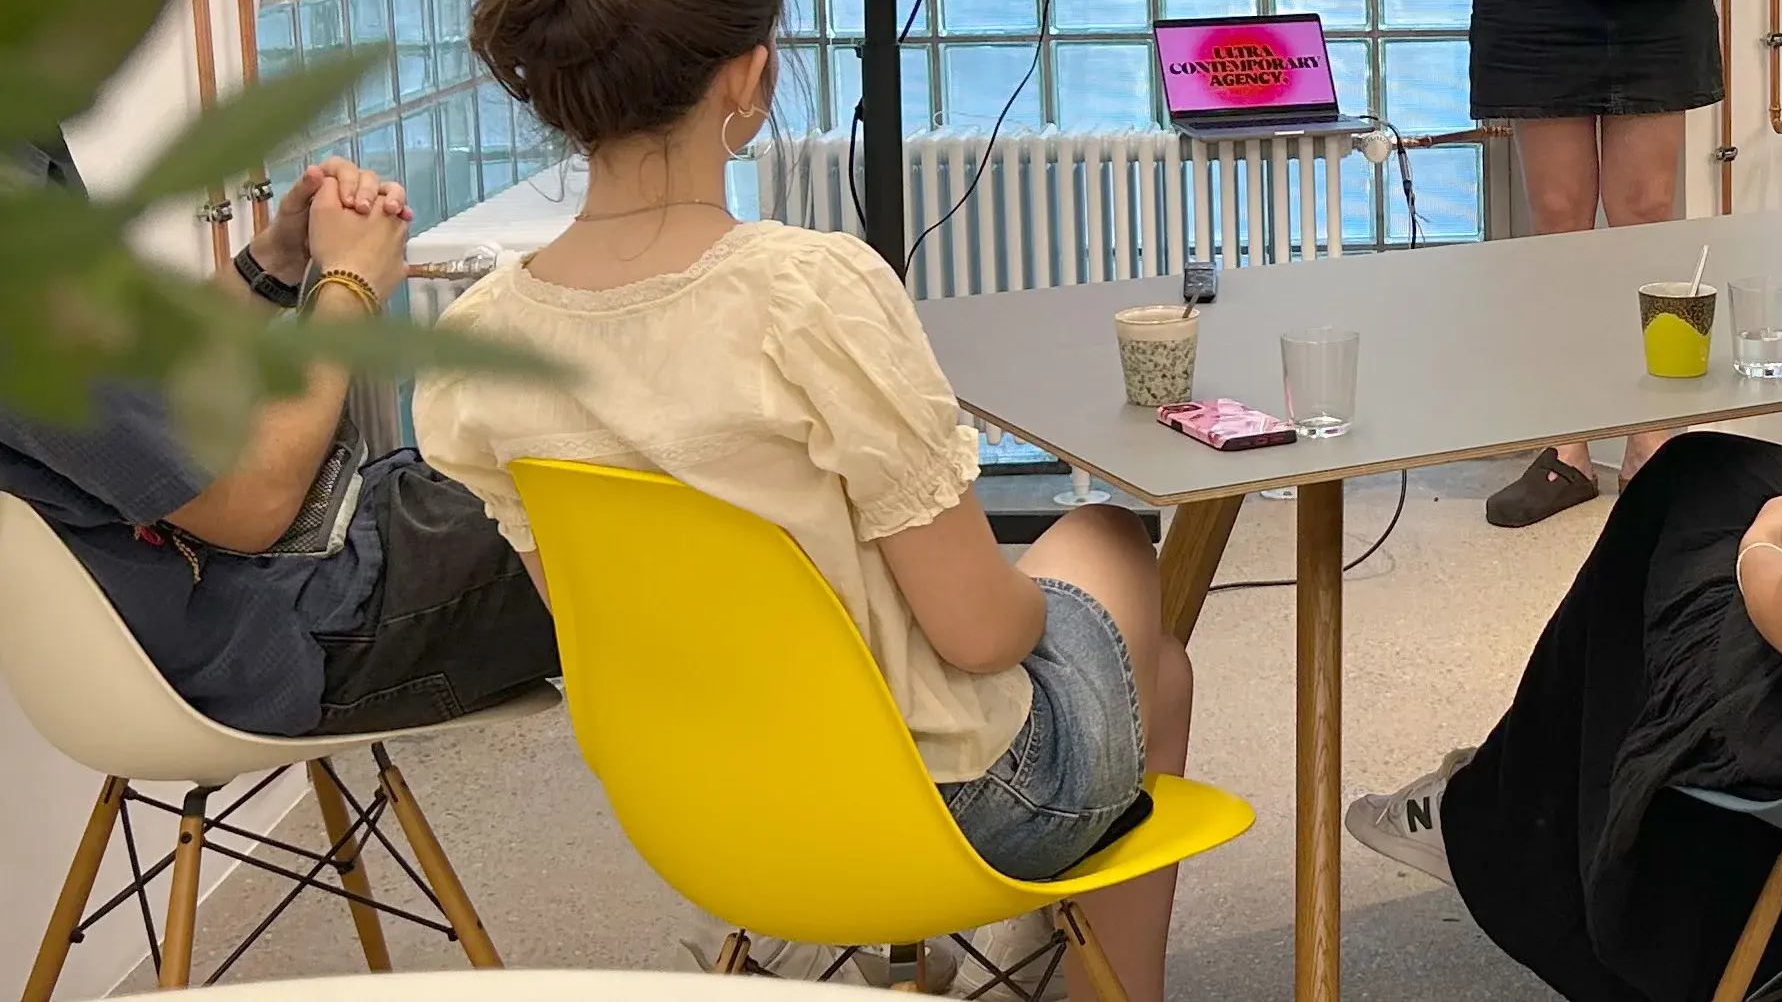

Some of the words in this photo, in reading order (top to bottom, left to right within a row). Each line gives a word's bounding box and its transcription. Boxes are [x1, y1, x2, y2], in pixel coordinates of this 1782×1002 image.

[1212, 44, 1274, 59] ULTRA
[1169, 56, 1321, 75] CONTEMPORARY
[1210, 71, 1290, 87] AGENCY.
[1406, 796, 1433, 833] N
